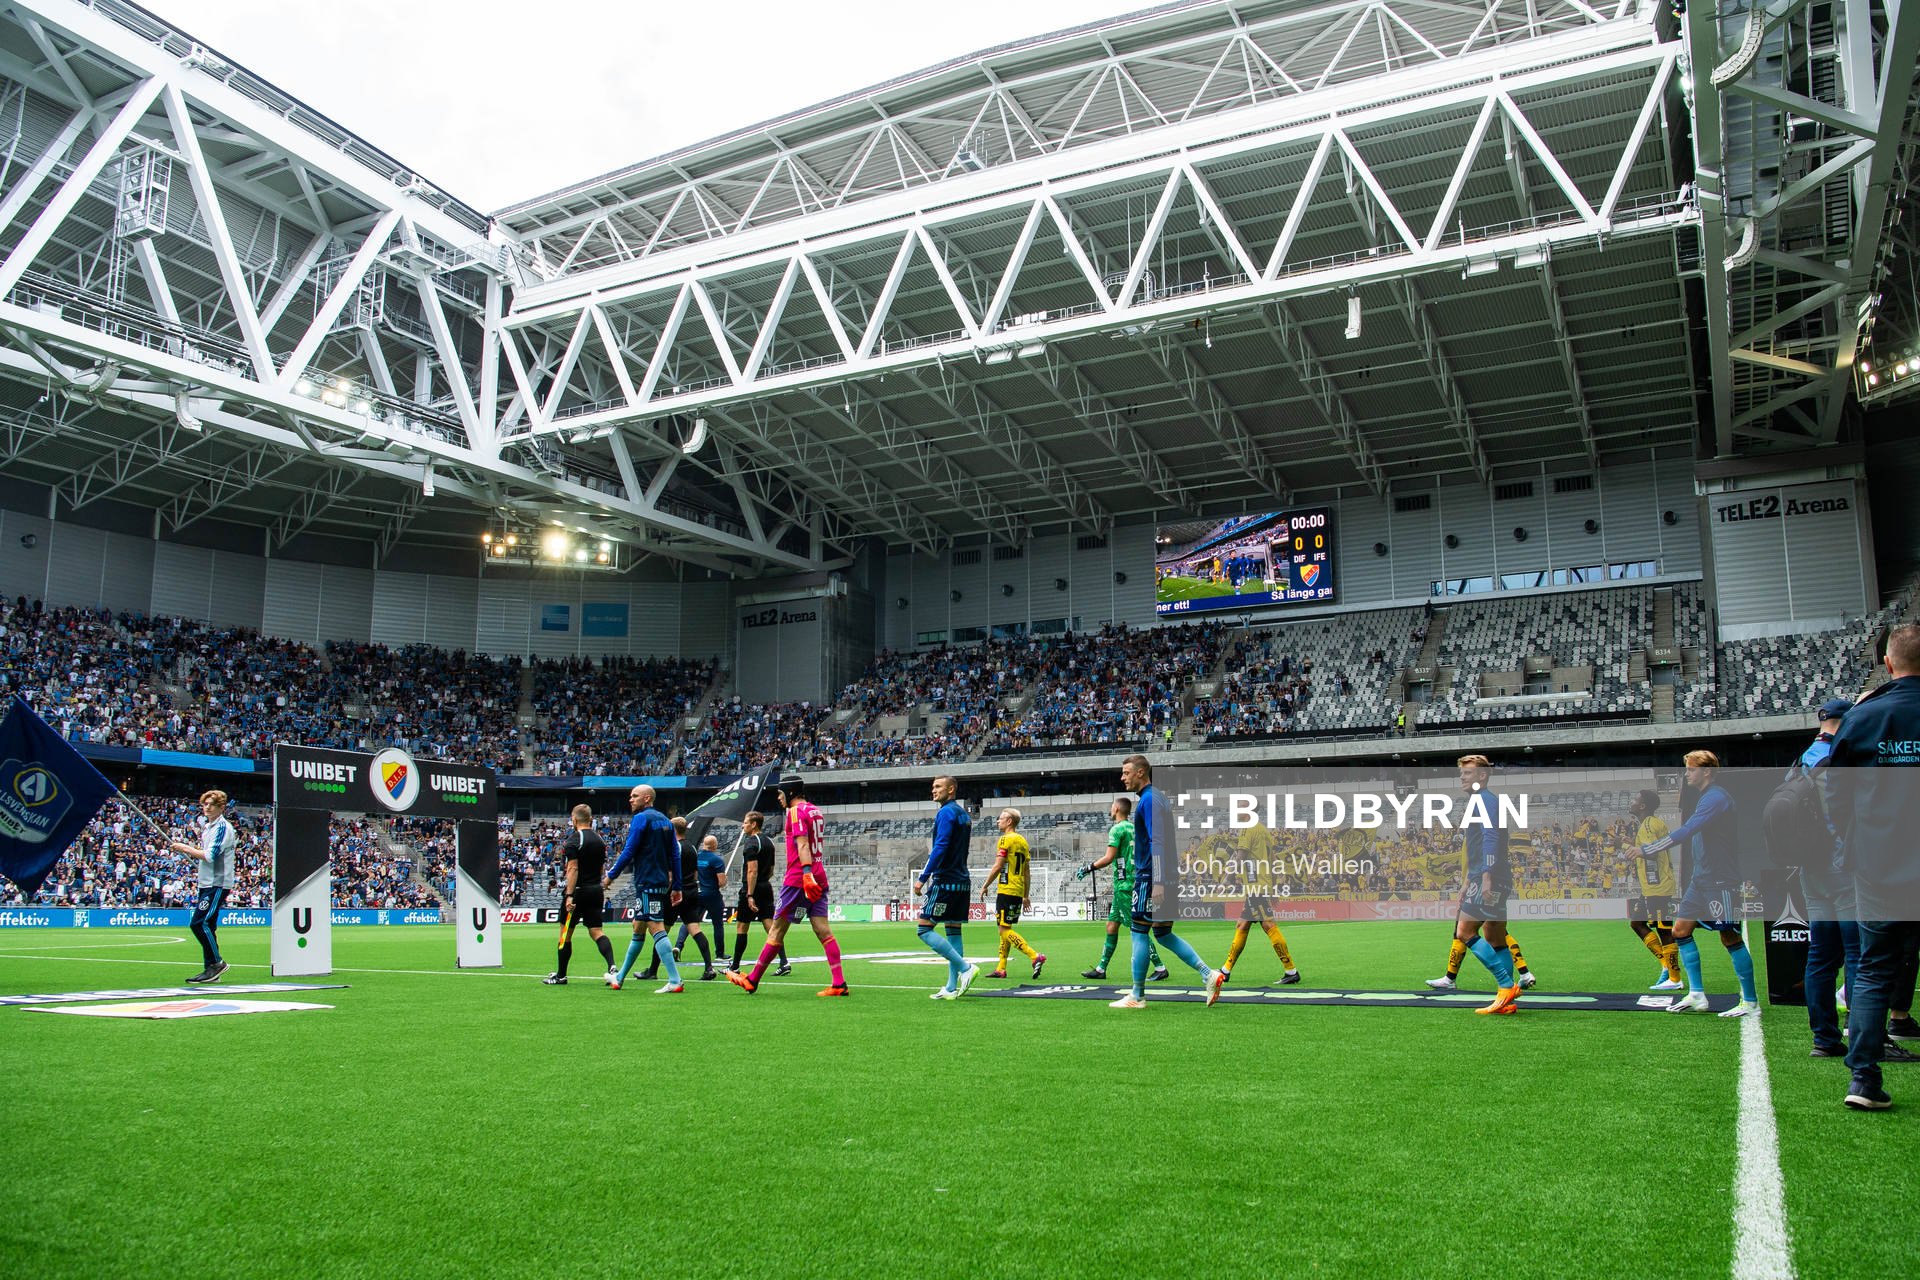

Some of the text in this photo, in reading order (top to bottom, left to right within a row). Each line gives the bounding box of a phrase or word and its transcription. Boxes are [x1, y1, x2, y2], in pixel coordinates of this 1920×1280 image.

[1717, 495, 1849, 523] TELE2 Arena
[1291, 514, 1325, 530] 00:00
[1295, 534, 1323, 550] 0 0
[1293, 552, 1326, 563] DIF IFE
[1174, 599, 1190, 610] ett!
[1271, 590, 1285, 601] Så
[1287, 588, 1315, 599] länge
[742, 608, 817, 629] TELE2 Arena
[1878, 740, 1920, 754] SÄKER
[290, 759, 357, 783] UNIBET
[430, 774, 486, 794] UNIBET
[0, 789, 50, 828] LSVENSKAN
[331, 912, 361, 924] ktiv.se
[1178, 906, 1212, 918] .COM
[1375, 900, 1456, 919] Scandic
[110, 911, 169, 926] effektiv.se
[292, 907, 312, 934] U
[472, 907, 487, 931] U
[1771, 930, 1811, 942] SELECT
